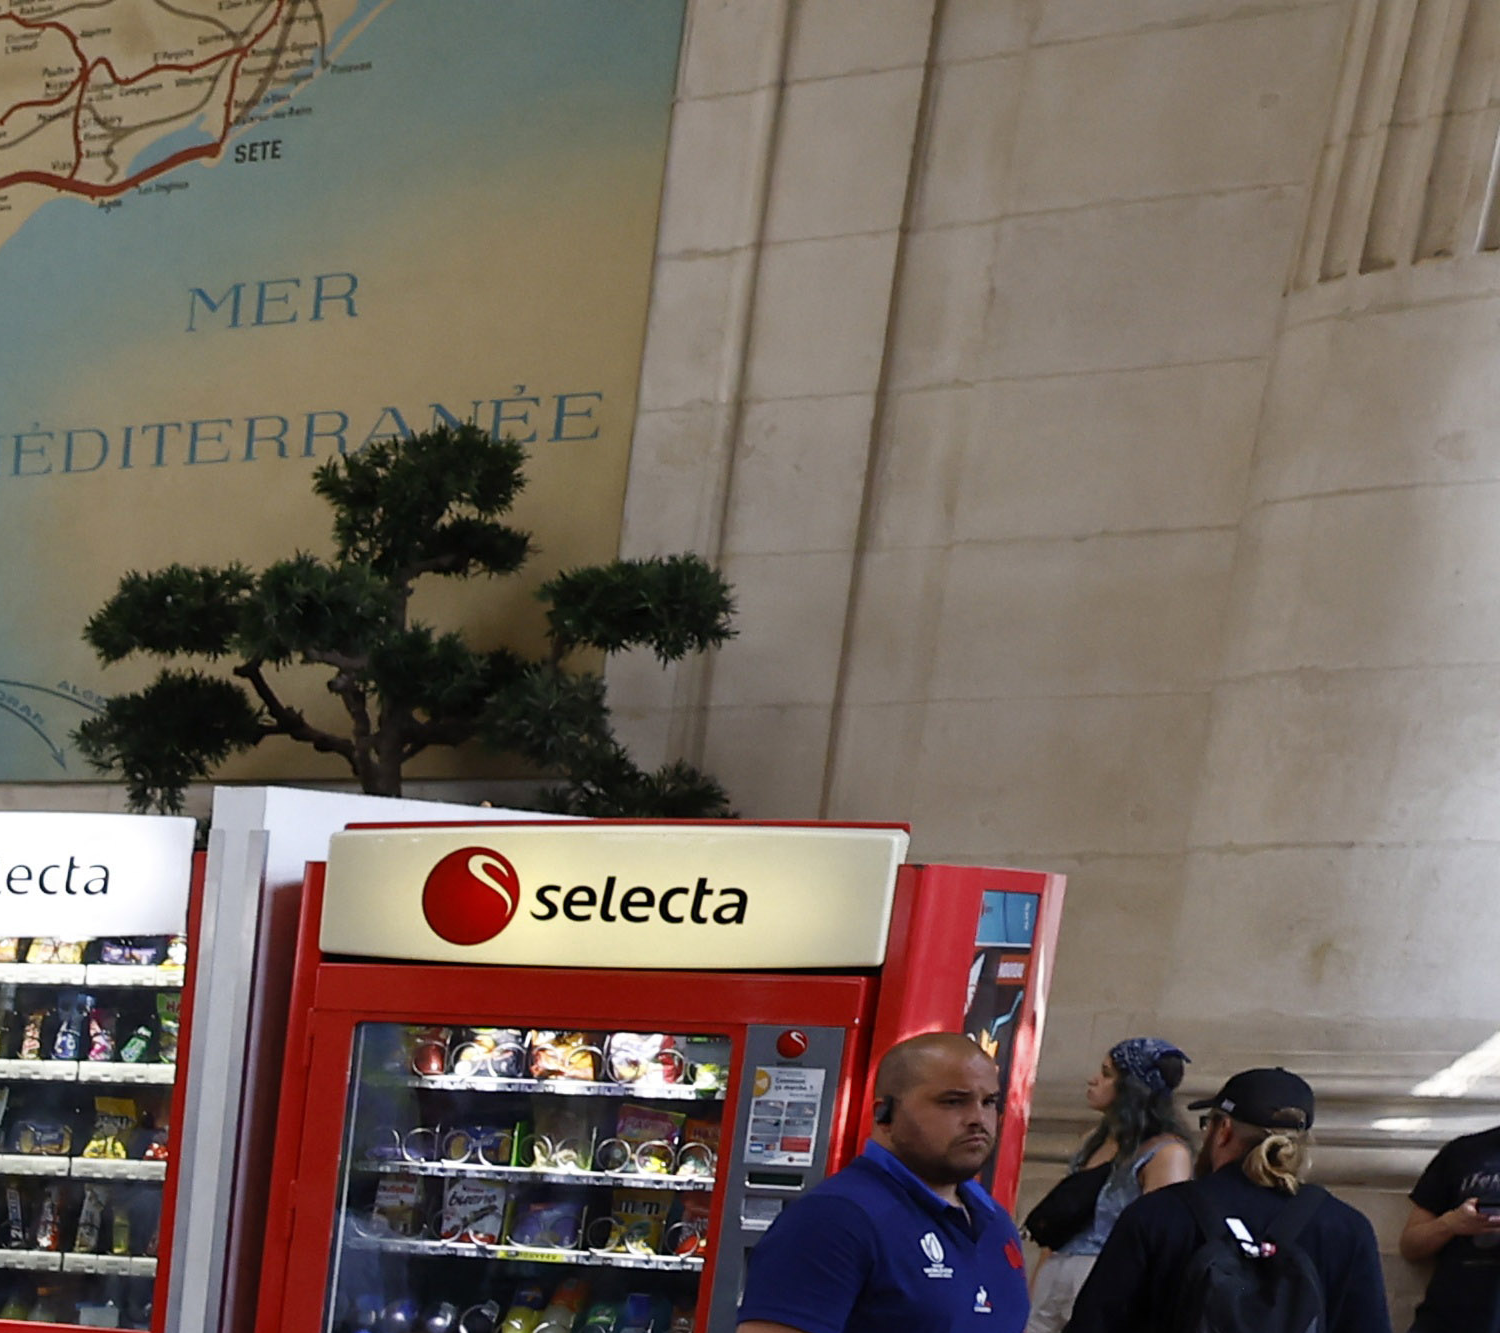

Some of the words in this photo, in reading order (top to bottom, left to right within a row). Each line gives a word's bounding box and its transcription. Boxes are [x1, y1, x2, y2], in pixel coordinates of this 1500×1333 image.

[234, 139, 283, 165] SETE
[185, 271, 362, 333] MER
[529, 875, 750, 926] selecta
[448, 1191, 498, 1207] bueno
